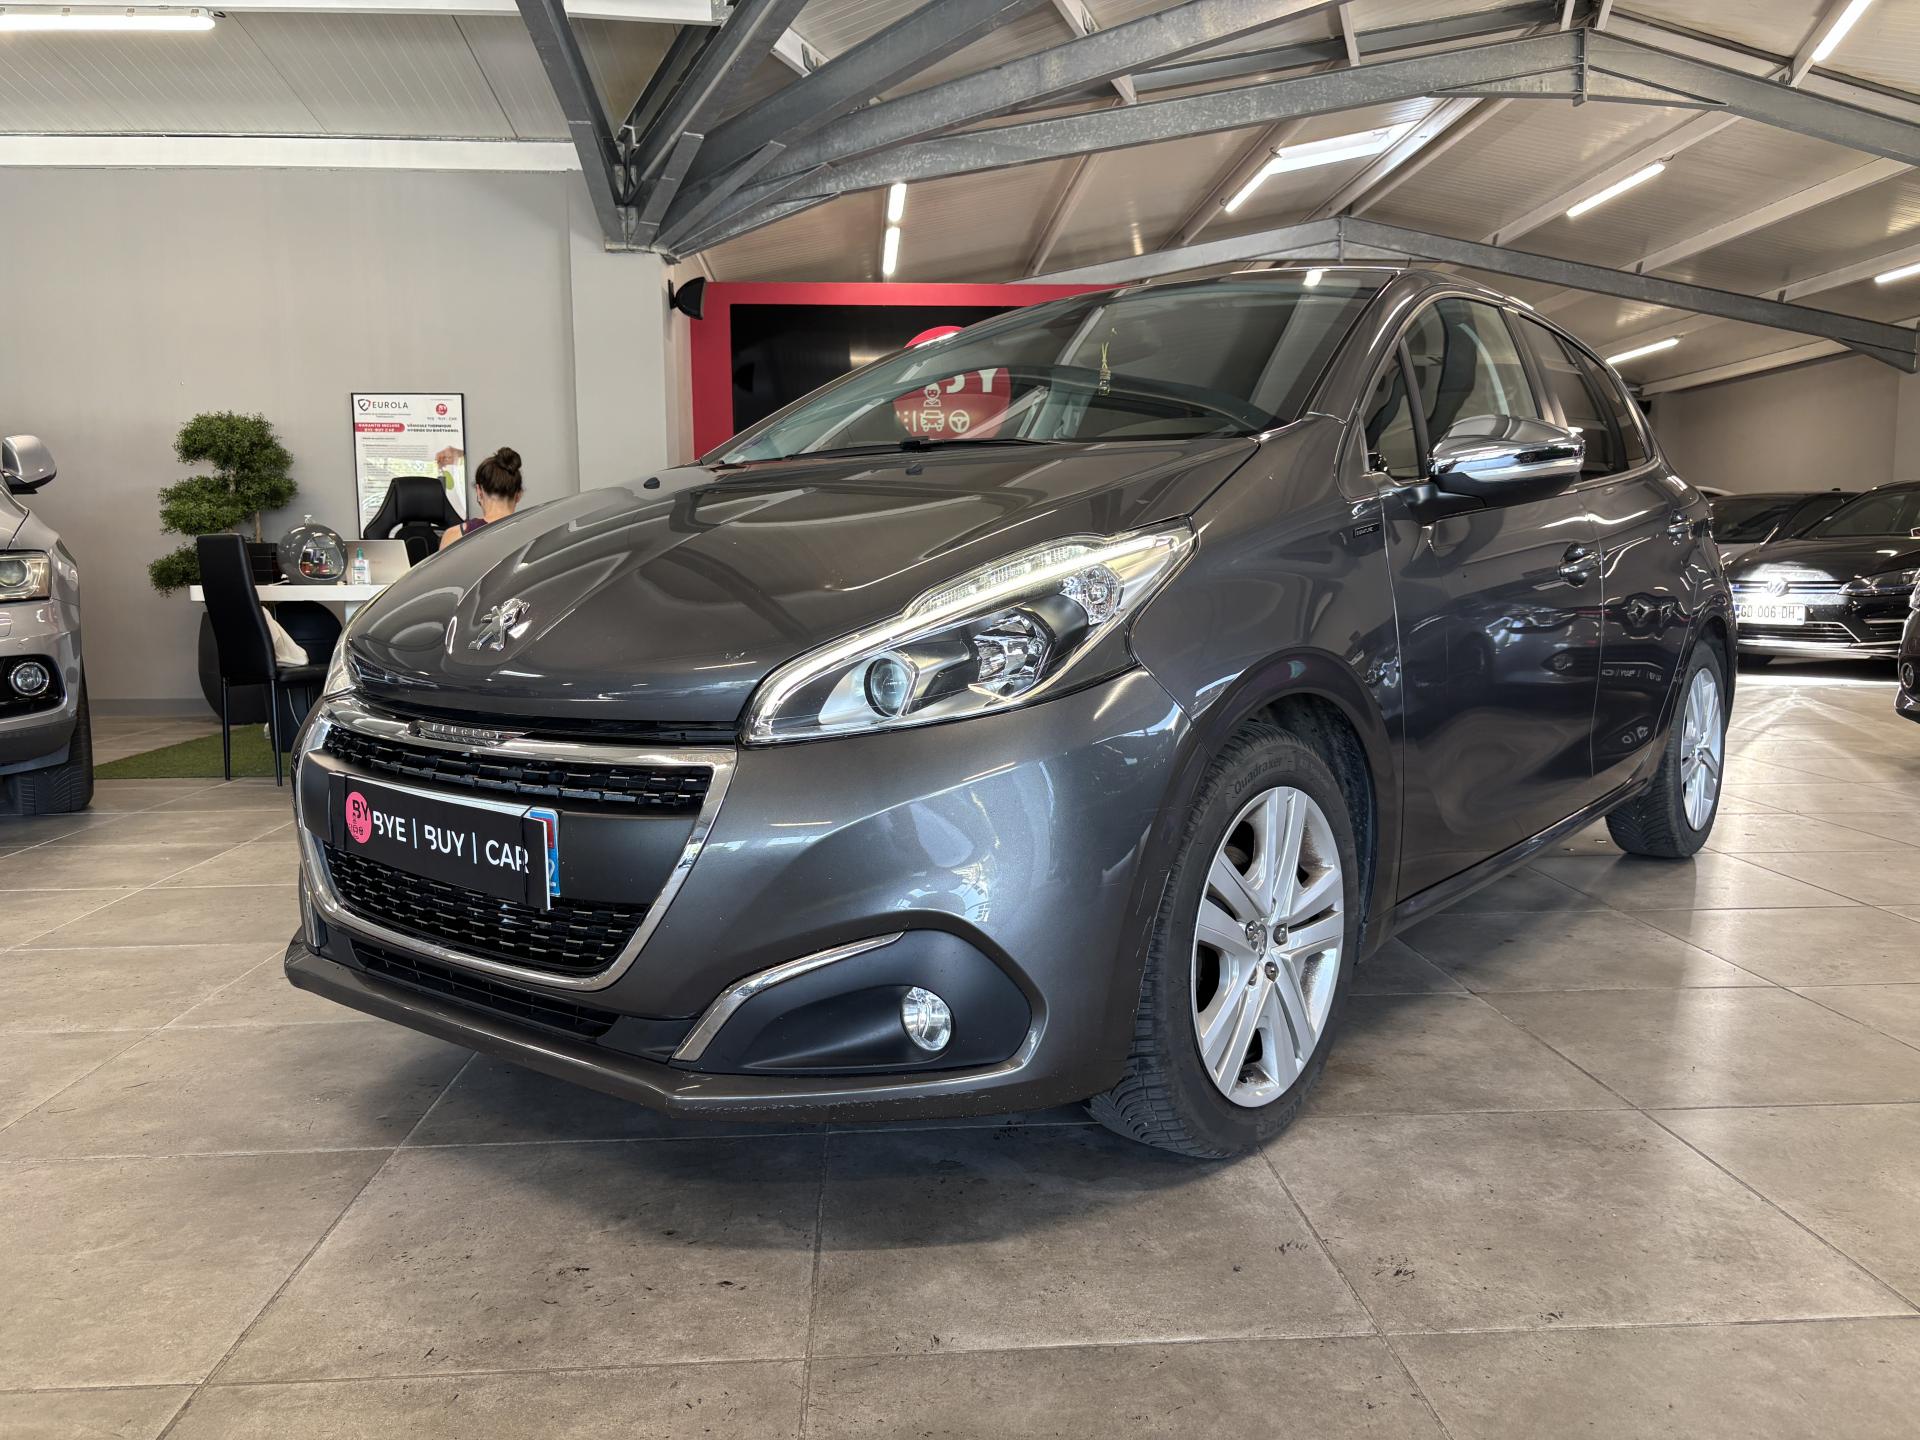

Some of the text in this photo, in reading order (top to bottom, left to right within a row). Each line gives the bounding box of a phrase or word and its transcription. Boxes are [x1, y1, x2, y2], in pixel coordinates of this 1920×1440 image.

[372, 401, 409, 409] EUROLA
[372, 810, 530, 874] BYE BUY CAR
